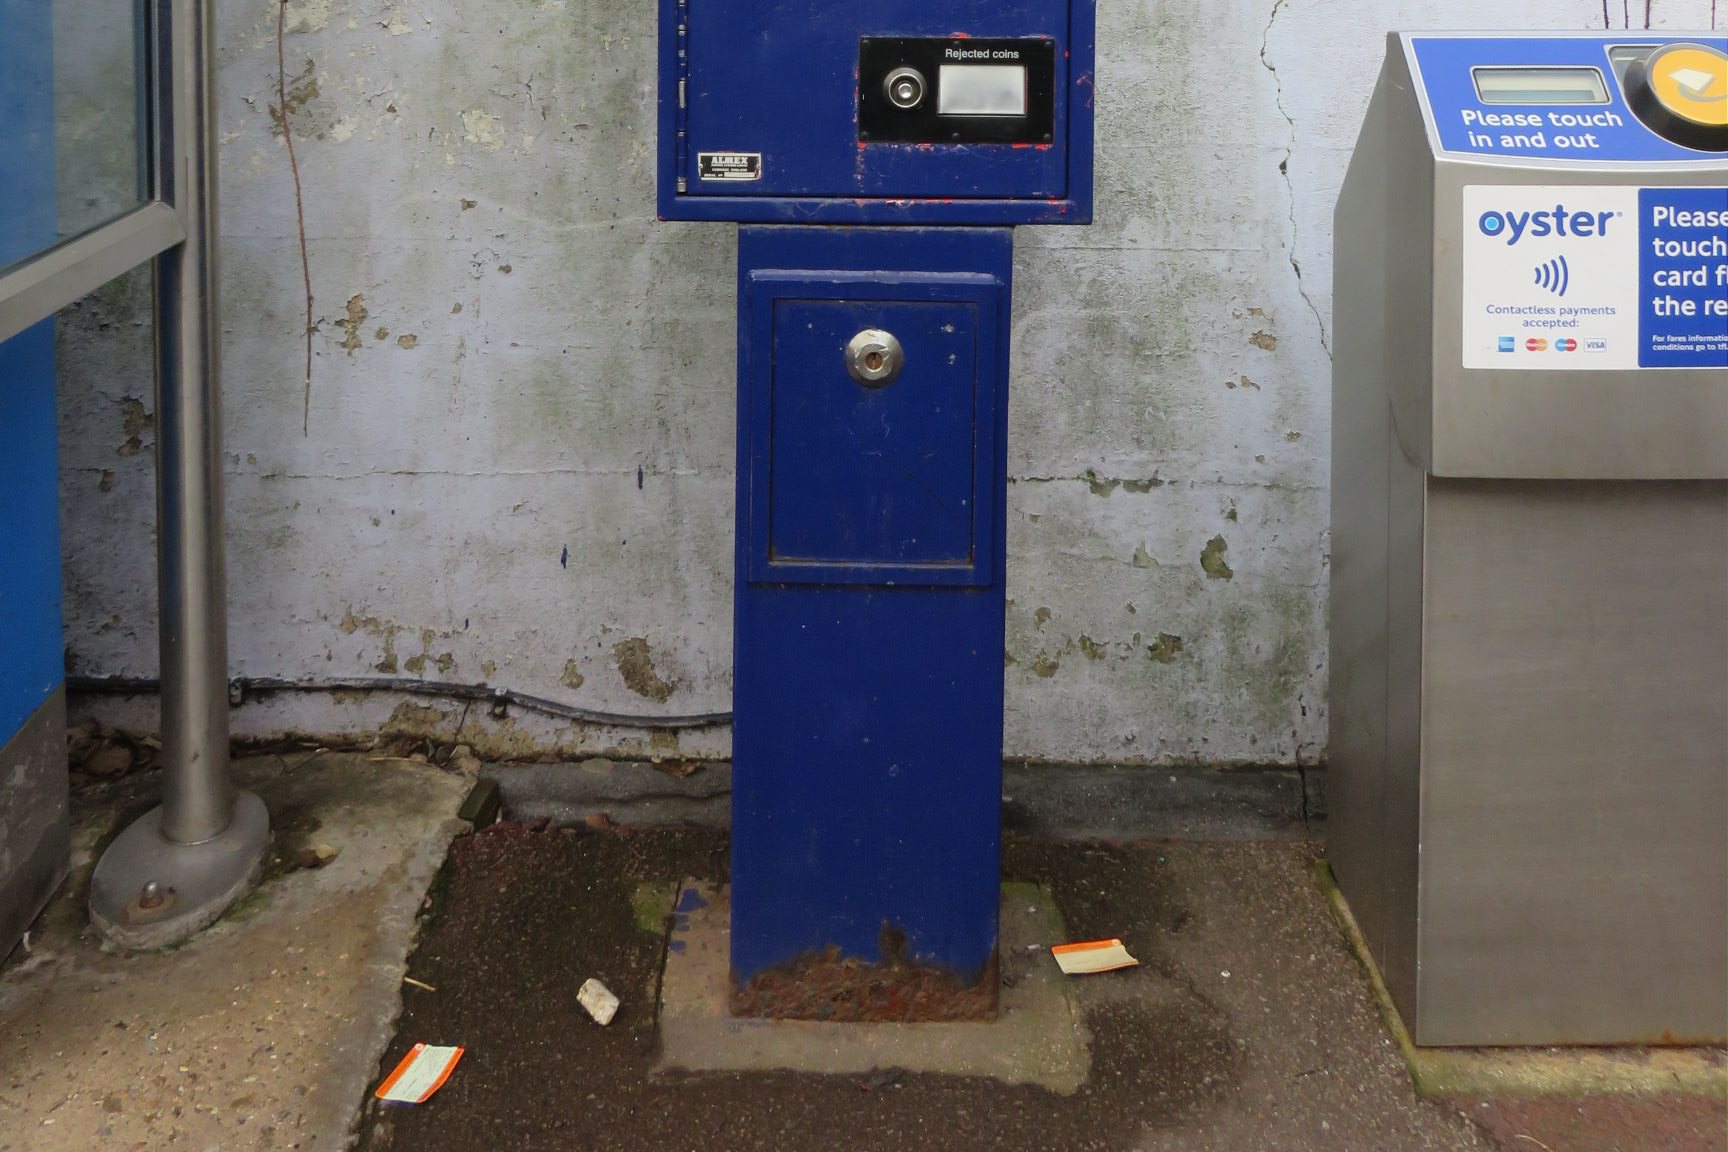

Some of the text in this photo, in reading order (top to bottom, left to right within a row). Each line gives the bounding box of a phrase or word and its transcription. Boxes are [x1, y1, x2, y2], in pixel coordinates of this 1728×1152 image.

[945, 48, 1019, 60] Rejected coins
[1461, 110, 1623, 127] Please touch
[1468, 131, 1600, 148] in and out
[1479, 204, 1614, 246] oyster
[1653, 206, 1728, 227] Please
[1652, 235, 1727, 257] touch
[1653, 265, 1707, 287] card
[1486, 304, 1616, 317] Contactless payments
[1652, 295, 1696, 316] the
[1522, 318, 1579, 329] accepted:
[1652, 343, 1694, 351] conditions
